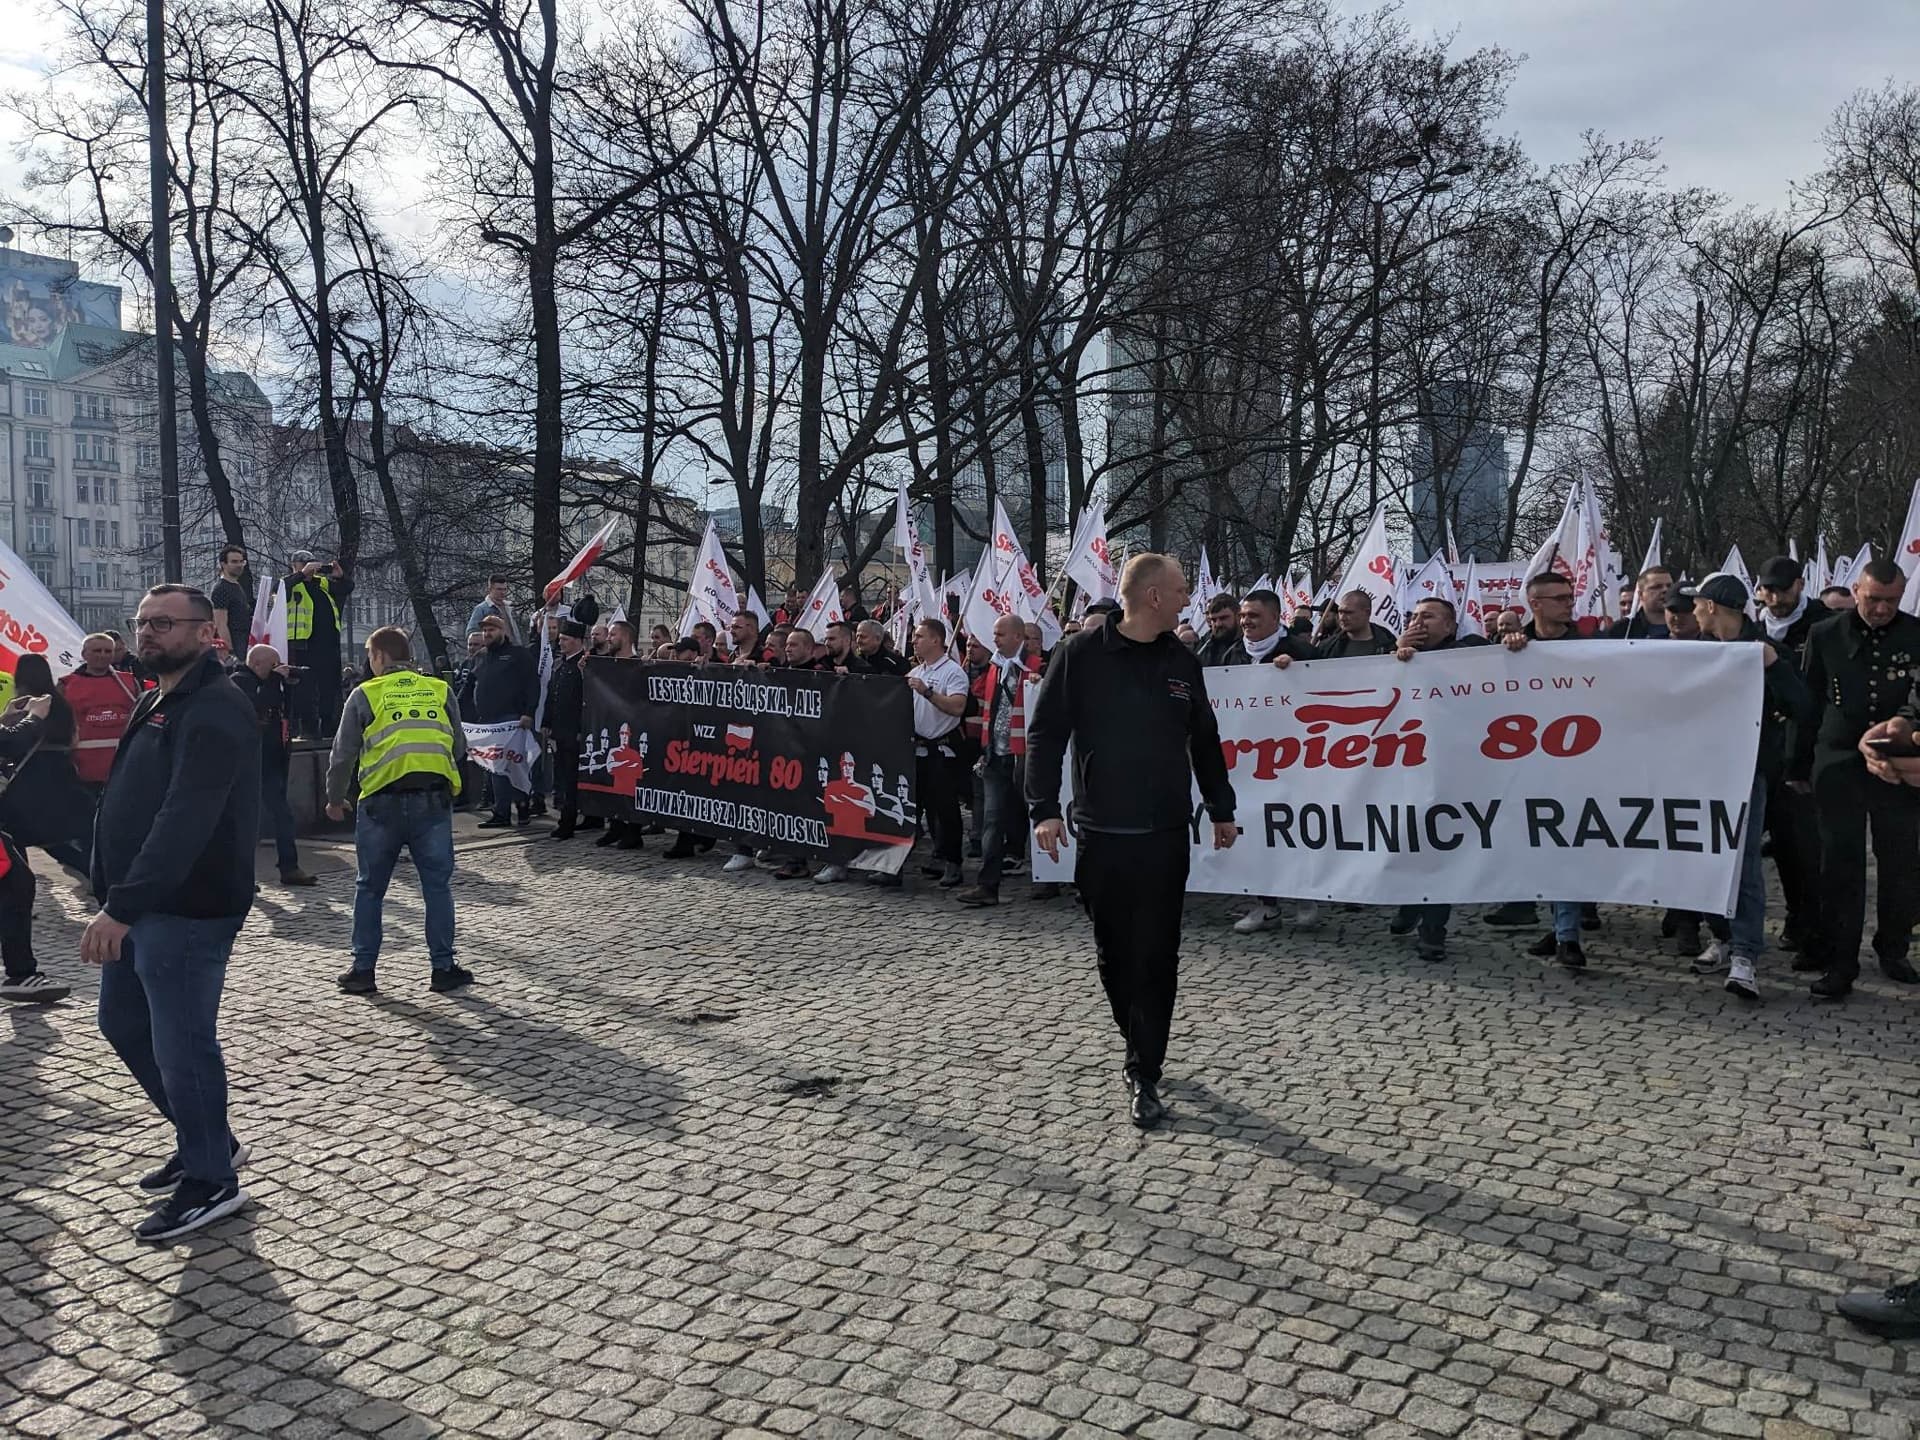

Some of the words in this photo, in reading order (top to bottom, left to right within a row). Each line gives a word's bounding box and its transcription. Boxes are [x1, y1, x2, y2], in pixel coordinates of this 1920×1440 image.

[648, 675, 714, 706] JESTEŚMY
[716, 681, 734, 708] ZE
[734, 679, 793, 717] ŚLĄSKA,
[794, 689, 822, 718] ALE
[1209, 695, 1293, 711] WIĄZEK
[1411, 675, 1597, 700] ZAWODOWY
[693, 723, 716, 739] WZZ
[1220, 718, 1427, 780] rpień
[1480, 714, 1602, 760] 80
[664, 739, 760, 786] Sierpień
[770, 755, 802, 790] 80
[635, 786, 735, 827] NAJWAŻNIEJSZA
[737, 806, 767, 833] JEST
[768, 811, 829, 847] POLSKA
[1264, 799, 1502, 853] ROLNICY
[1525, 797, 1748, 855] RAZEM
